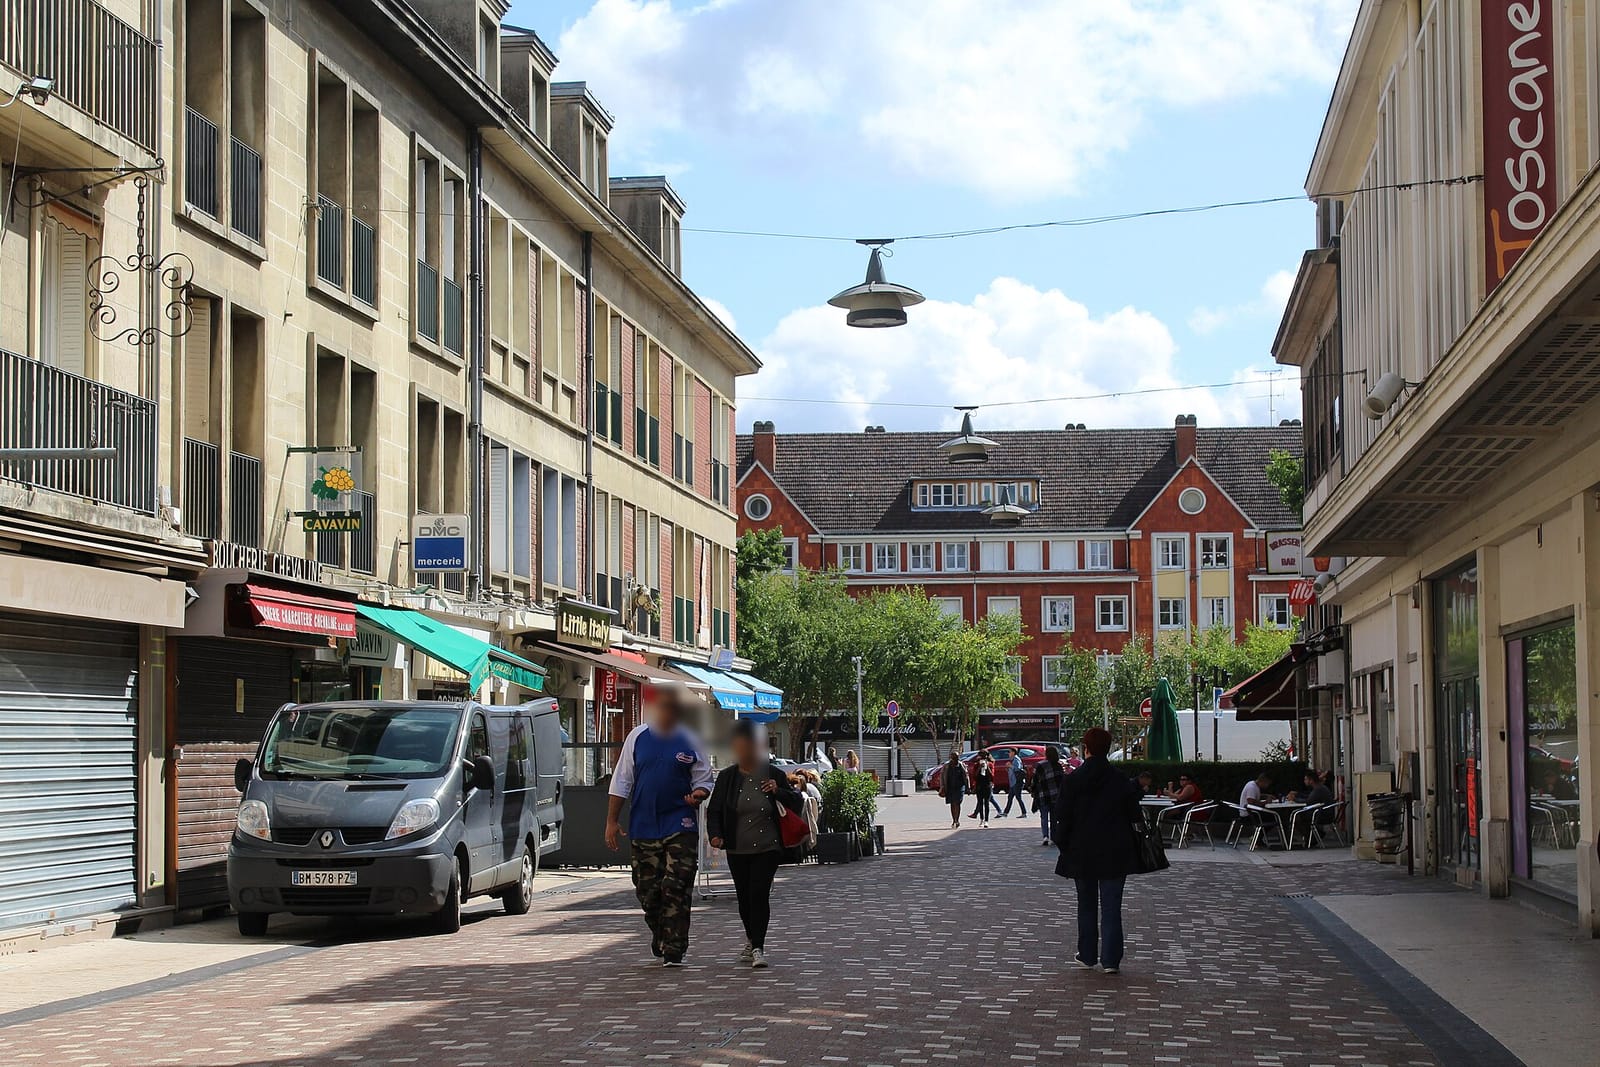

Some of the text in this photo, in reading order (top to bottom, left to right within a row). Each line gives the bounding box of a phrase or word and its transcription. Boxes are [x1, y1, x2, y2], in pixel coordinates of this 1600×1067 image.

[303, 518, 360, 530] CAVAVIN
[418, 526, 460, 537] DMC
[213, 540, 323, 583] BOUCHERIE CHEVALINE
[417, 556, 462, 566] mercerie
[1281, 557, 1296, 567] BAR
[1290, 582, 1315, 603] illy
[562, 611, 610, 644] Little Italy
[350, 631, 383, 653] CAVAVIN
